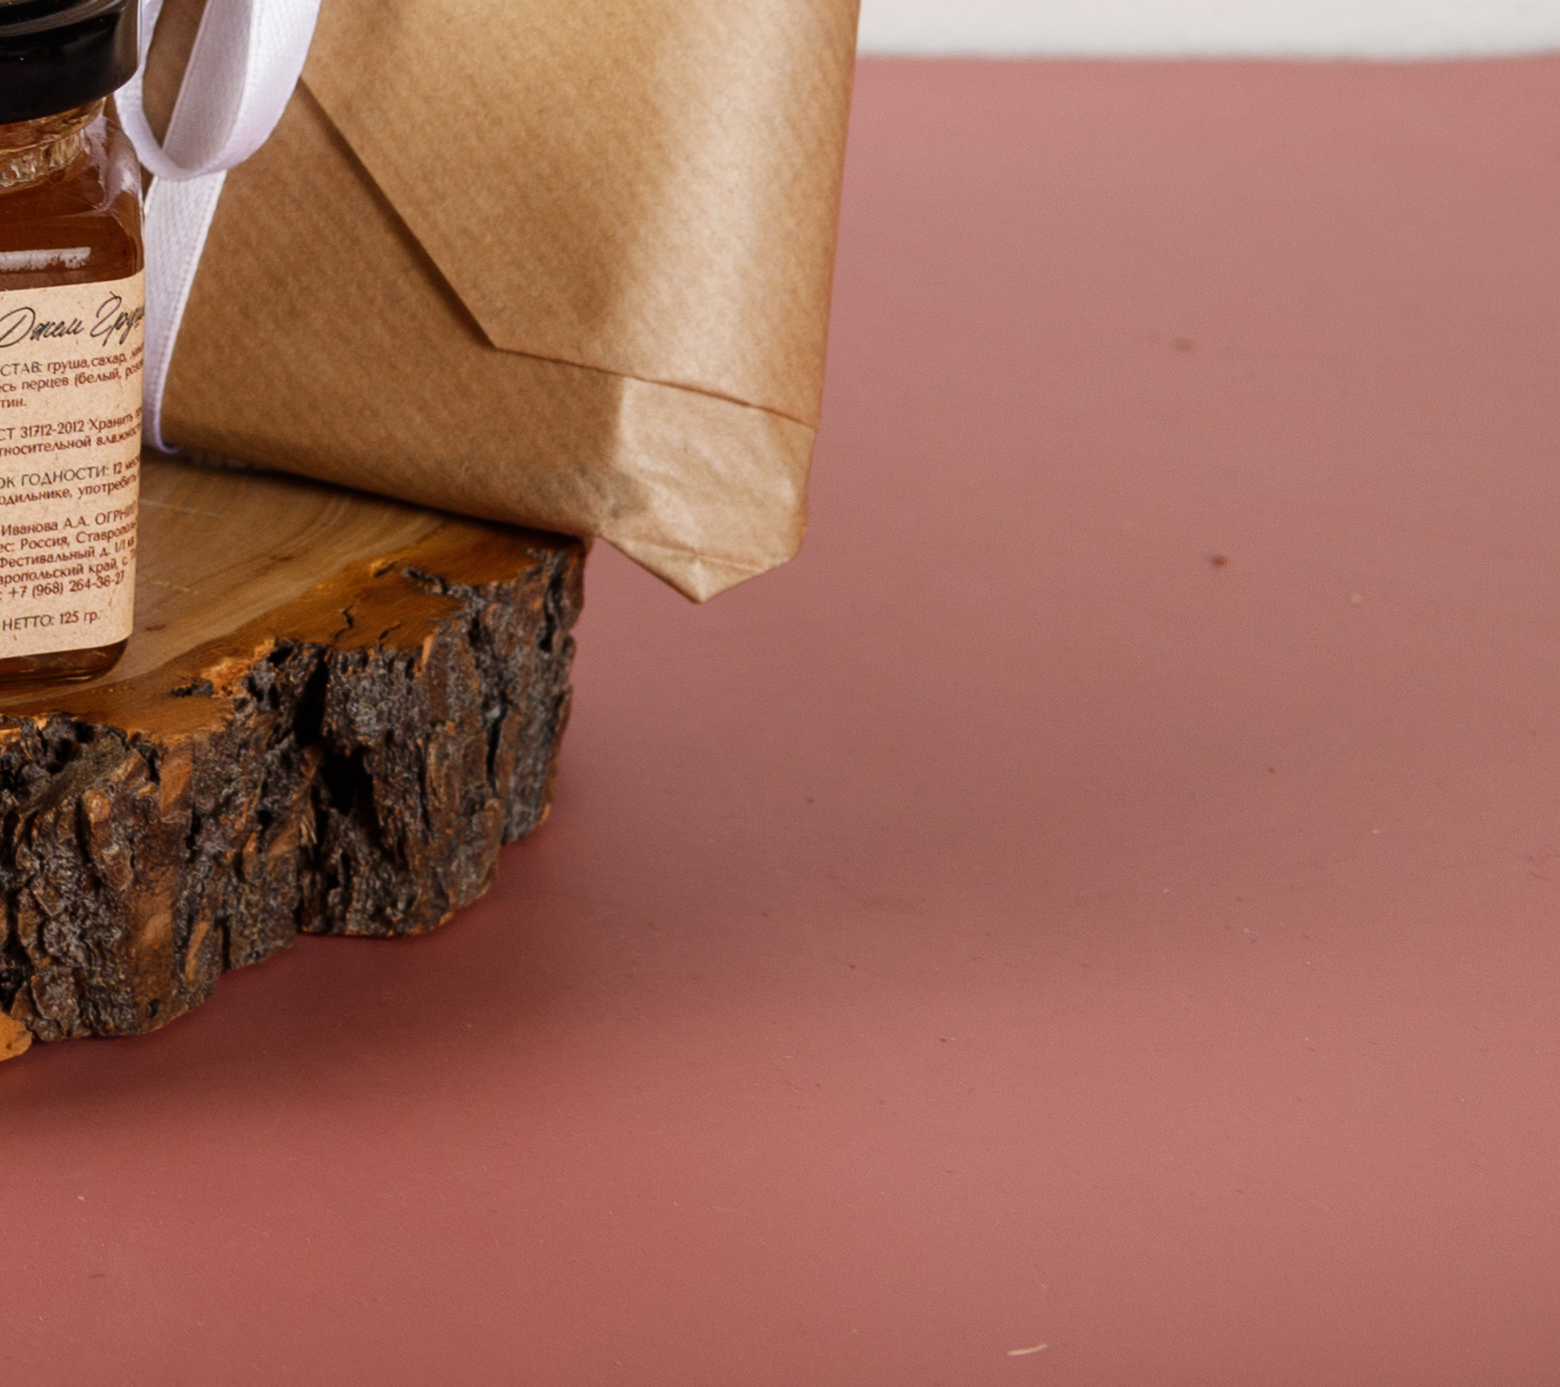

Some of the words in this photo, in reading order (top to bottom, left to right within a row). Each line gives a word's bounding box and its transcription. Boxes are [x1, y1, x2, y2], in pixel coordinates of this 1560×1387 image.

[20, 374, 70, 392] перцев
[19, 419, 86, 440] 31712-2012
[20, 464, 110, 487] ГОДНОСТИ:
[0, 519, 59, 538] Иванова
[62, 515, 91, 530] А.А.
[19, 535, 71, 551] Россия,
[7, 584, 28, 599] +7
[30, 580, 64, 599] (968)
[1, 612, 55, 632] НЕТТО:
[59, 609, 81, 625] 125
